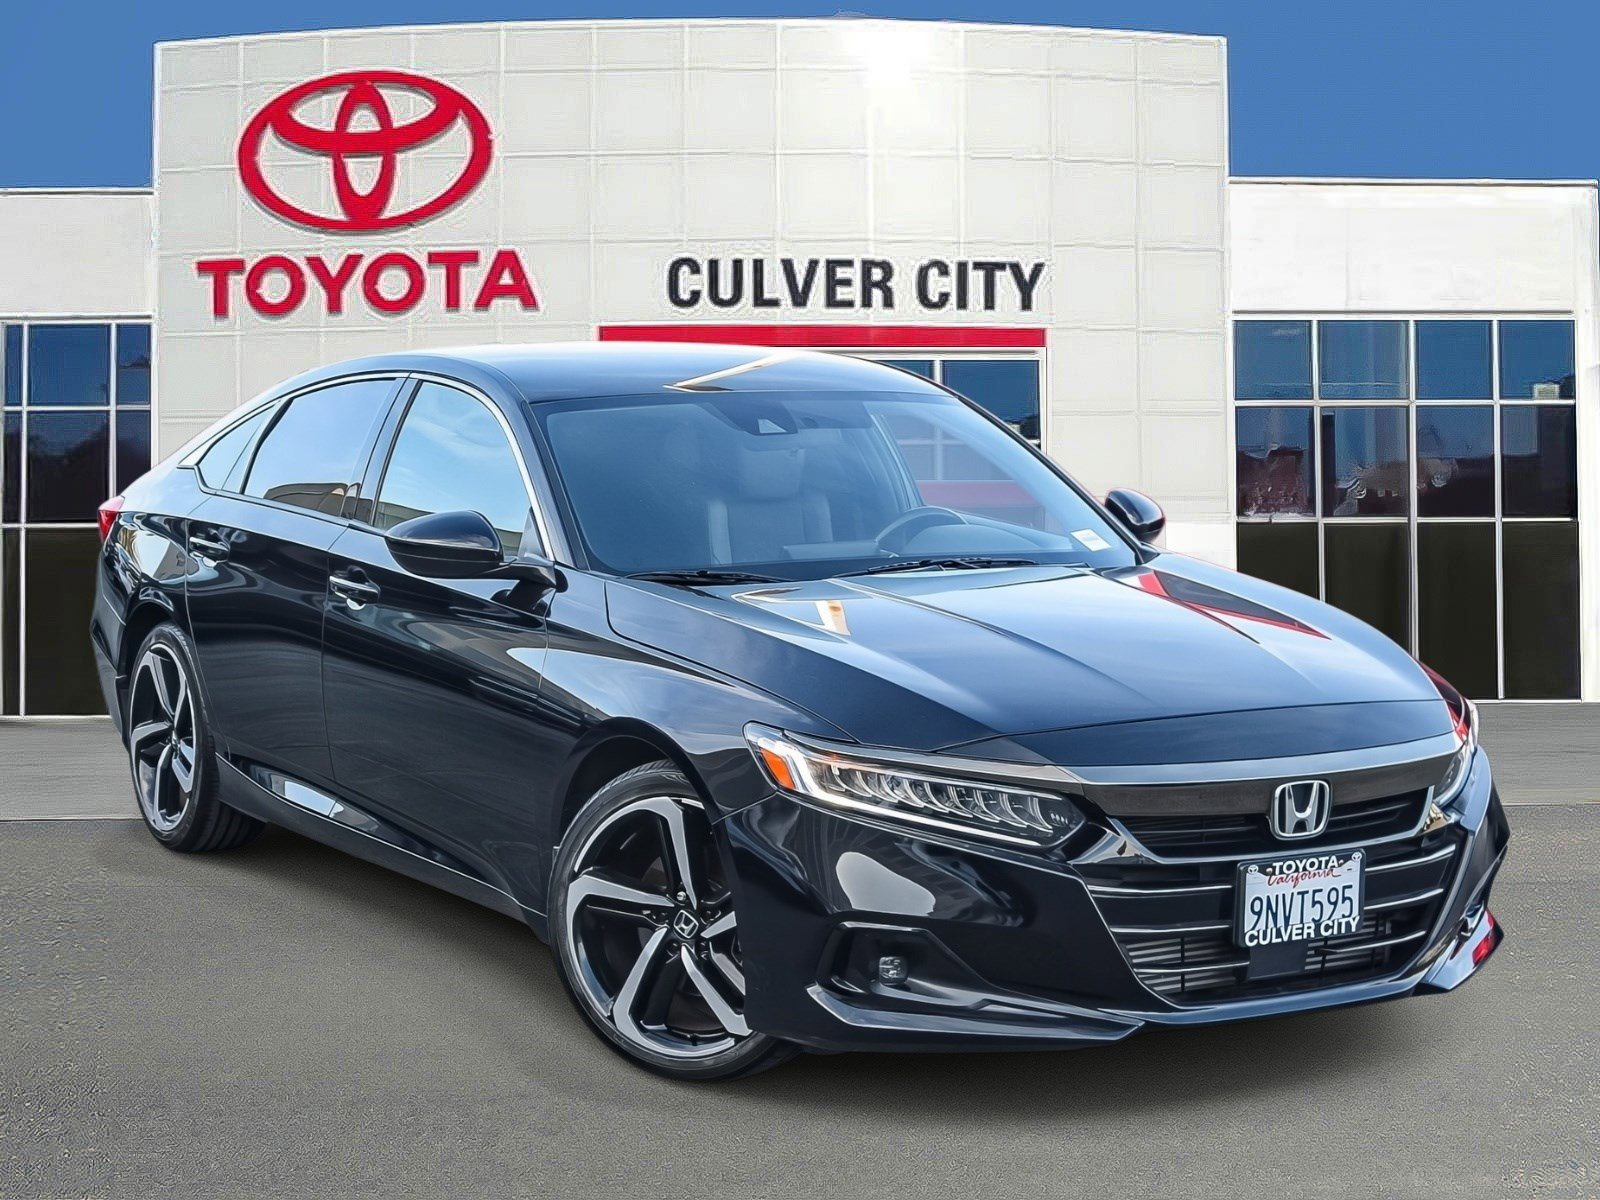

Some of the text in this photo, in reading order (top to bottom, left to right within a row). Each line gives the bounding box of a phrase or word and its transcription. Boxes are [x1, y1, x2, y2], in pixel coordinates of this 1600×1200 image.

[196, 249, 540, 320] TOYOTA
[667, 257, 1046, 311] CULVER CITY
[1267, 867, 1341, 888] California
[1273, 856, 1339, 876] TOYOTA
[1250, 884, 1354, 931] 9NVT595
[1245, 915, 1361, 947] CULVER CITY
